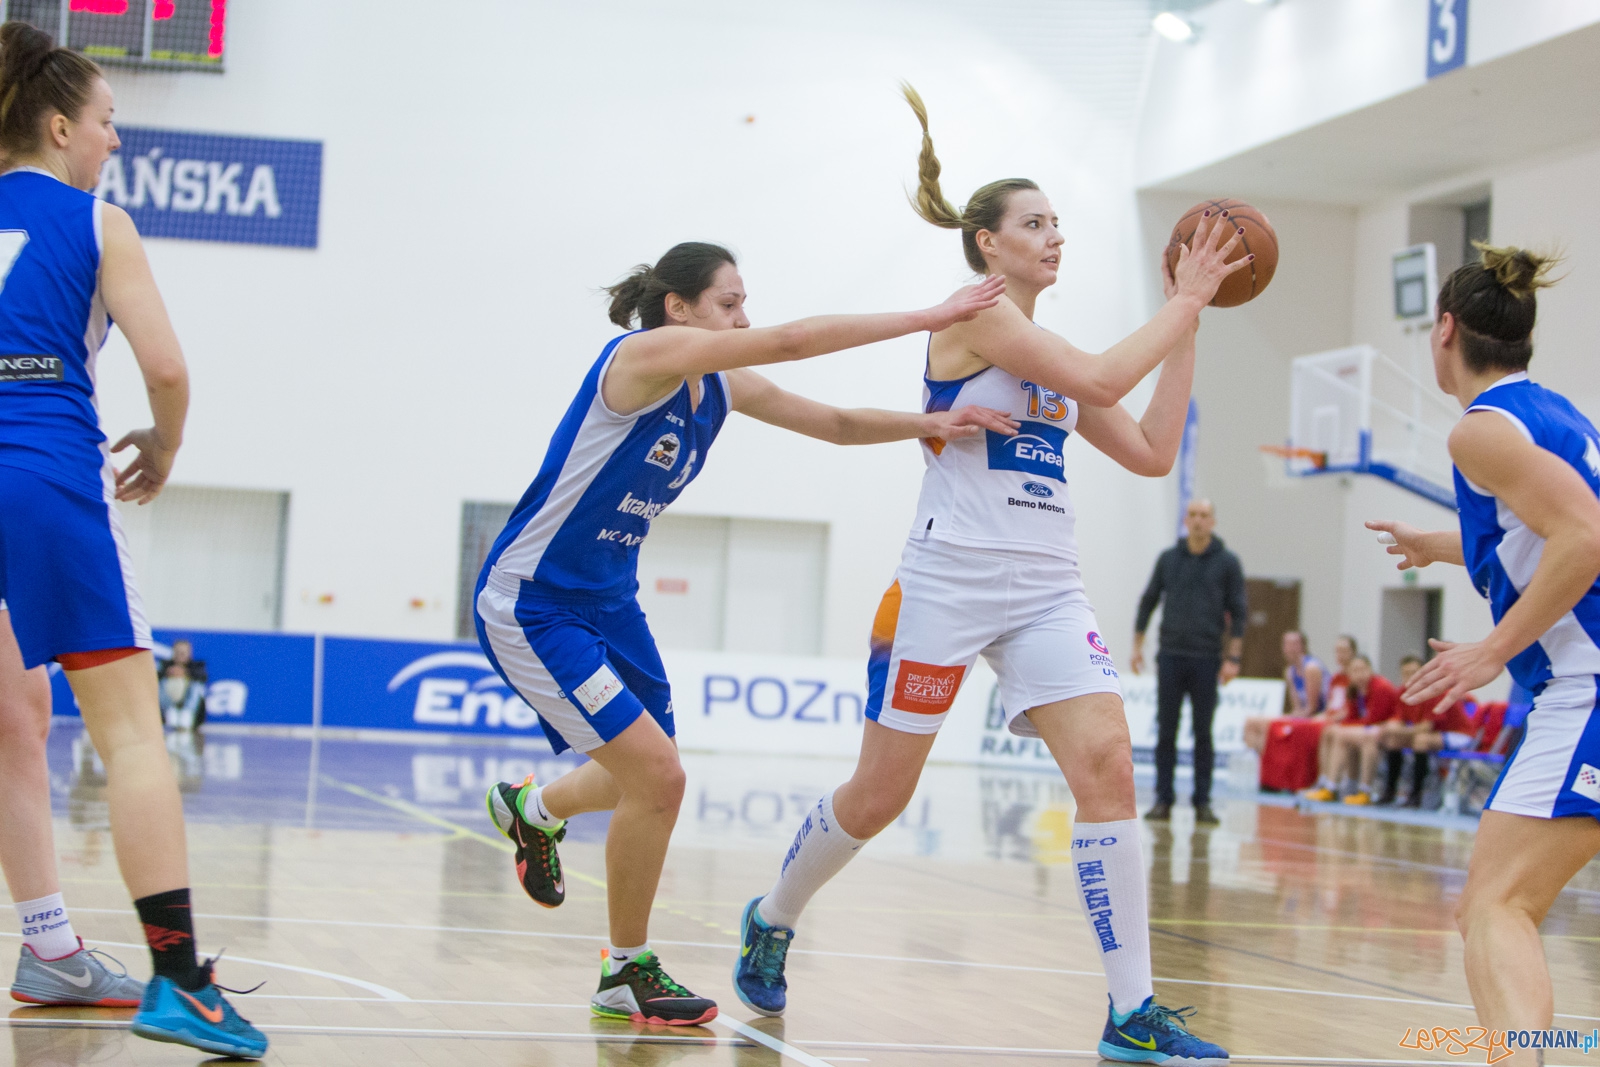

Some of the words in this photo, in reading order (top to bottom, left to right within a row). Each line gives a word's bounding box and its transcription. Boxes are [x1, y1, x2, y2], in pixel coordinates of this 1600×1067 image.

[1020, 380, 1069, 421] 13
[1015, 442, 1063, 467] Enea
[1008, 497, 1036, 509] Bemo
[1038, 501, 1065, 514] Motors
[904, 682, 953, 697] SZPIKU
[907, 673, 948, 686] DRUŻYNA
[413, 678, 538, 729] Ene
[702, 674, 864, 724] POZn
[980, 736, 1054, 760] RAFL
[1083, 887, 1110, 911] AZS
[1090, 909, 1122, 954] Poznań
